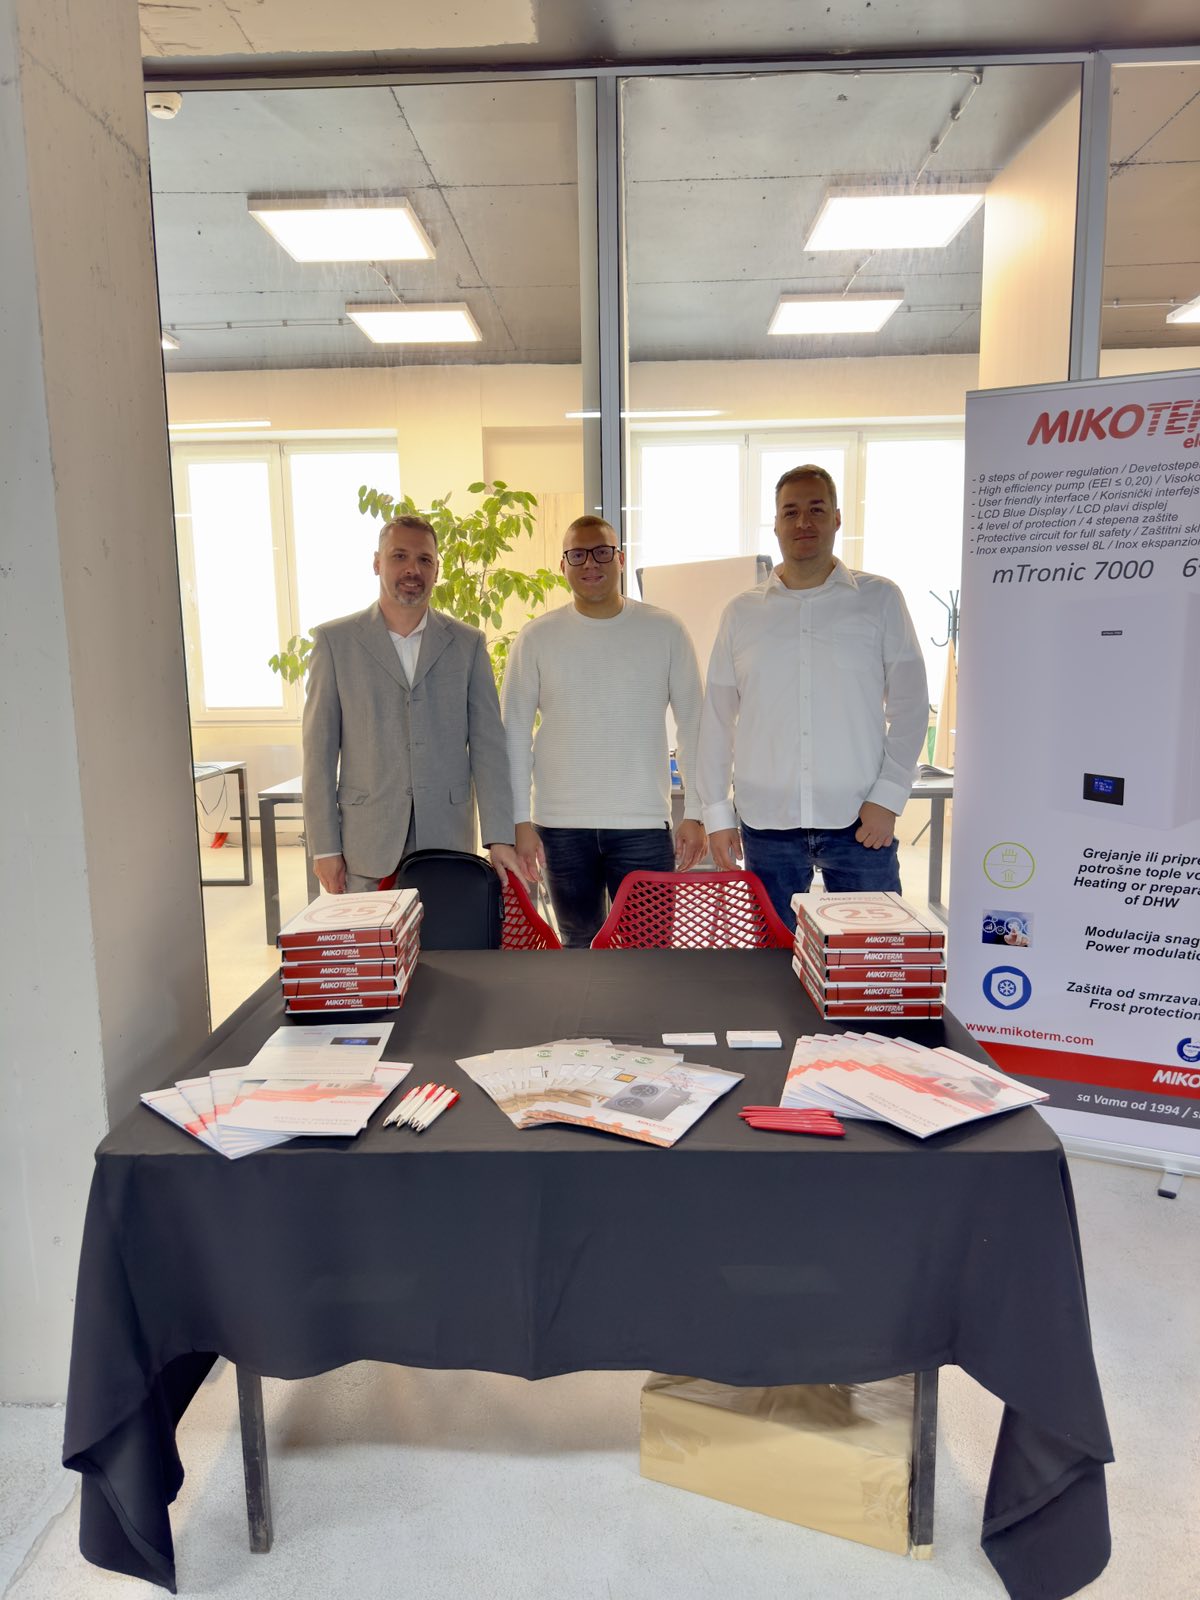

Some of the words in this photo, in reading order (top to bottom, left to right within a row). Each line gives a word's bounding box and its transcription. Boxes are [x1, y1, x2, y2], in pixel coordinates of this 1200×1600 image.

[1183, 433, 1200, 448] el
[979, 473, 986, 483] 9
[988, 473, 1015, 483] steps
[1018, 470, 1030, 480] of
[1030, 470, 1063, 481] power
[1065, 465, 1119, 479] regulation
[1128, 460, 1200, 473] Devetostepe
[978, 485, 1002, 496] High
[1004, 483, 1052, 494] efficiency
[1054, 482, 1085, 492] pump
[1088, 478, 1112, 490] (EEI
[978, 498, 1002, 508] User
[1004, 495, 1042, 506] friendly
[1044, 492, 1090, 503] interface
[1100, 488, 1153, 500] Korisnički
[1155, 485, 1200, 498] interfejs
[977, 509, 1000, 519] LCD
[1002, 508, 1026, 518] Blue
[1028, 506, 1067, 518] Display
[1076, 503, 1101, 514] LCD
[1103, 502, 1130, 514] plavi
[1132, 500, 1168, 512] displej
[977, 522, 984, 531] 4
[985, 521, 1010, 531] level
[1012, 519, 1024, 530] of
[1024, 518, 1076, 530] protection
[1085, 516, 1093, 526] 4
[1095, 515, 1139, 527] stepena
[1142, 513, 1179, 523] zaštite
[976, 532, 1027, 543] Protective
[1029, 531, 1061, 541] circuit
[1062, 529, 1078, 539] for
[1079, 528, 1096, 538] full
[1098, 527, 1132, 539] safety
[1140, 524, 1182, 535] Zaštitni
[976, 546, 998, 555] Inox
[999, 544, 1053, 555] expansion
[1055, 541, 1090, 552] vessel
[1092, 540, 1105, 550] 8L
[1115, 539, 1139, 550] Inox
[992, 562, 1086, 584] mTronic
[1093, 559, 1154, 581] 7000
[1182, 557, 1200, 578] 6
[1083, 847, 1142, 864] Grejanje
[1145, 851, 1159, 863] ili
[1077, 864, 1142, 876] potrošne
[1146, 867, 1182, 880] tople
[1073, 876, 1127, 892] Heating
[1131, 882, 1147, 891] or
[1124, 895, 1141, 905] of
[1142, 895, 1180, 908] DHW
[838, 908, 893, 919] 25
[317, 933, 355, 942] MIKOTERM
[864, 936, 905, 944] MIKOTERM
[1084, 925, 1160, 944] Modulacija
[321, 948, 359, 957] MIKOTERM
[1085, 940, 1130, 954] Power
[863, 952, 903, 960] MIKOTERM
[320, 966, 358, 975] MIKOTERM
[320, 980, 358, 989] MIKOTERM
[863, 987, 903, 995] MIKOTERM
[1066, 981, 1112, 996] Zaštita
[1116, 988, 1135, 999] od
[1138, 990, 1200, 1006] smrzava
[325, 998, 363, 1006] MIKOTERM
[1089, 998, 1126, 1012] Frost
[965, 1022, 1094, 1046] www.mikoterm.com
[1076, 1093, 1091, 1103] sa
[1094, 1094, 1128, 1108] Vama
[1130, 1101, 1147, 1111] od
[1149, 1102, 1180, 1116] 1994
